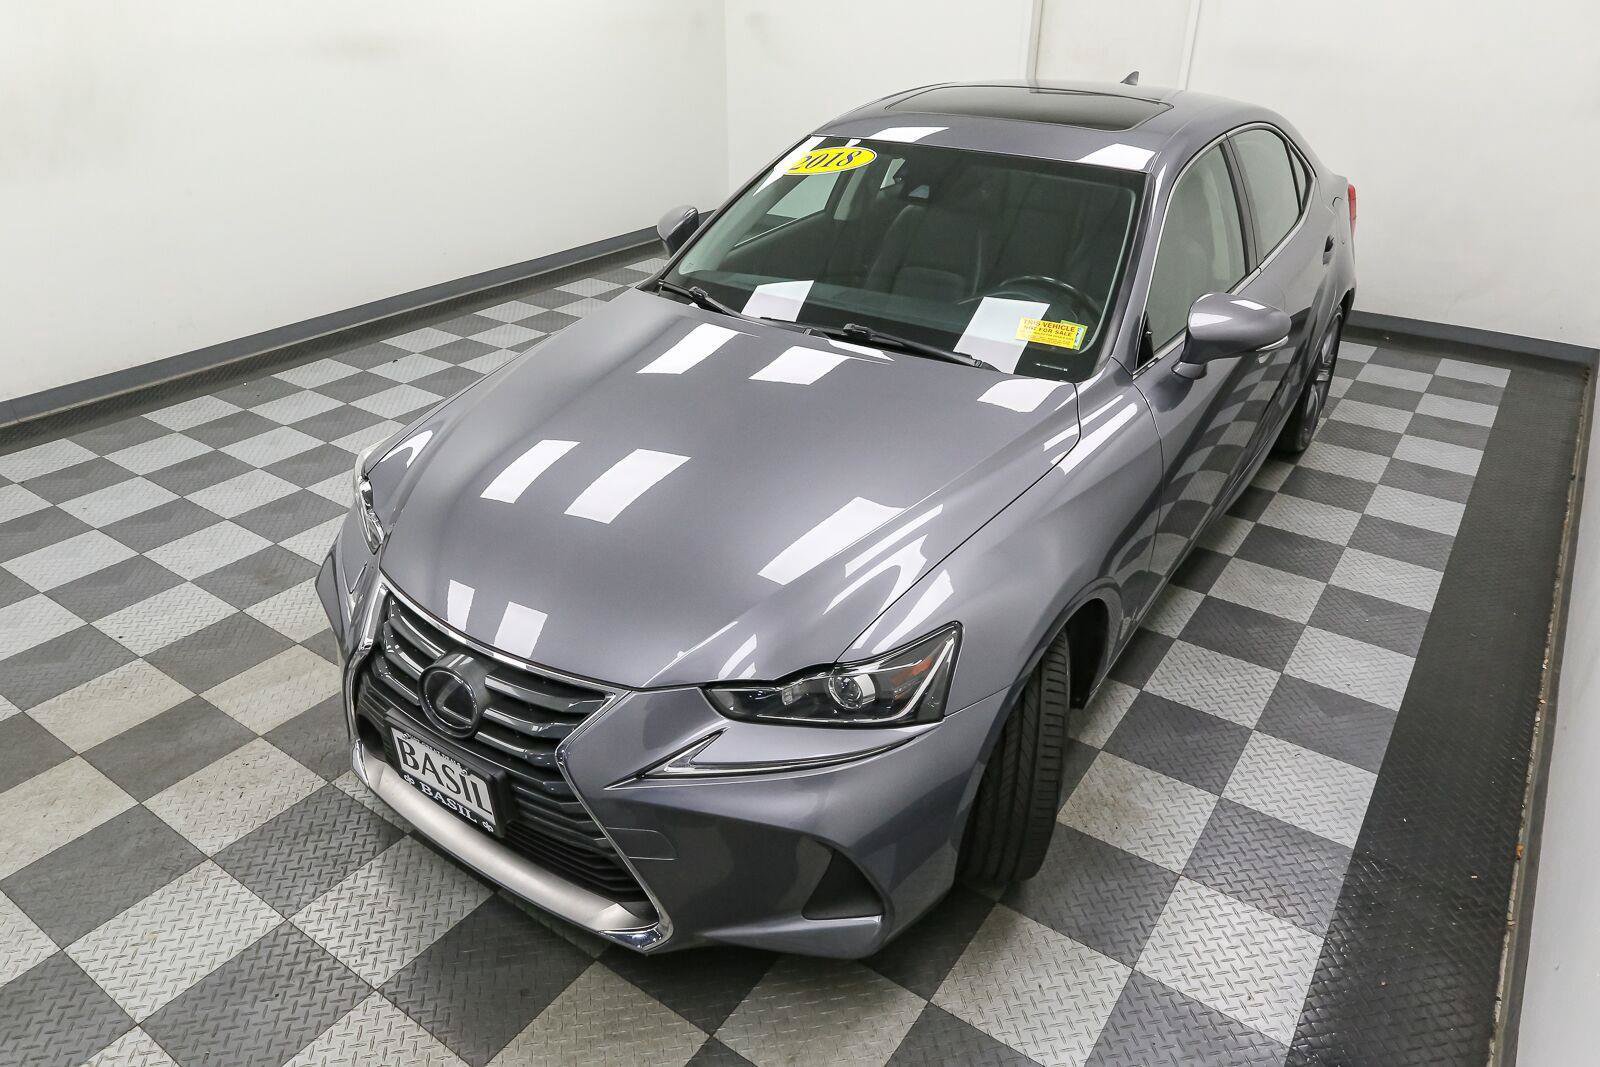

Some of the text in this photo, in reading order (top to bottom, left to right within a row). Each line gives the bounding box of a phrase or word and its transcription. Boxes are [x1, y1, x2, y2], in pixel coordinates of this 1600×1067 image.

[789, 150, 862, 171] 2018
[1043, 322, 1076, 333] VEHICLE
[1055, 329, 1073, 337] SALE
[396, 737, 493, 816] BASIL
[419, 780, 478, 824] BASIL
